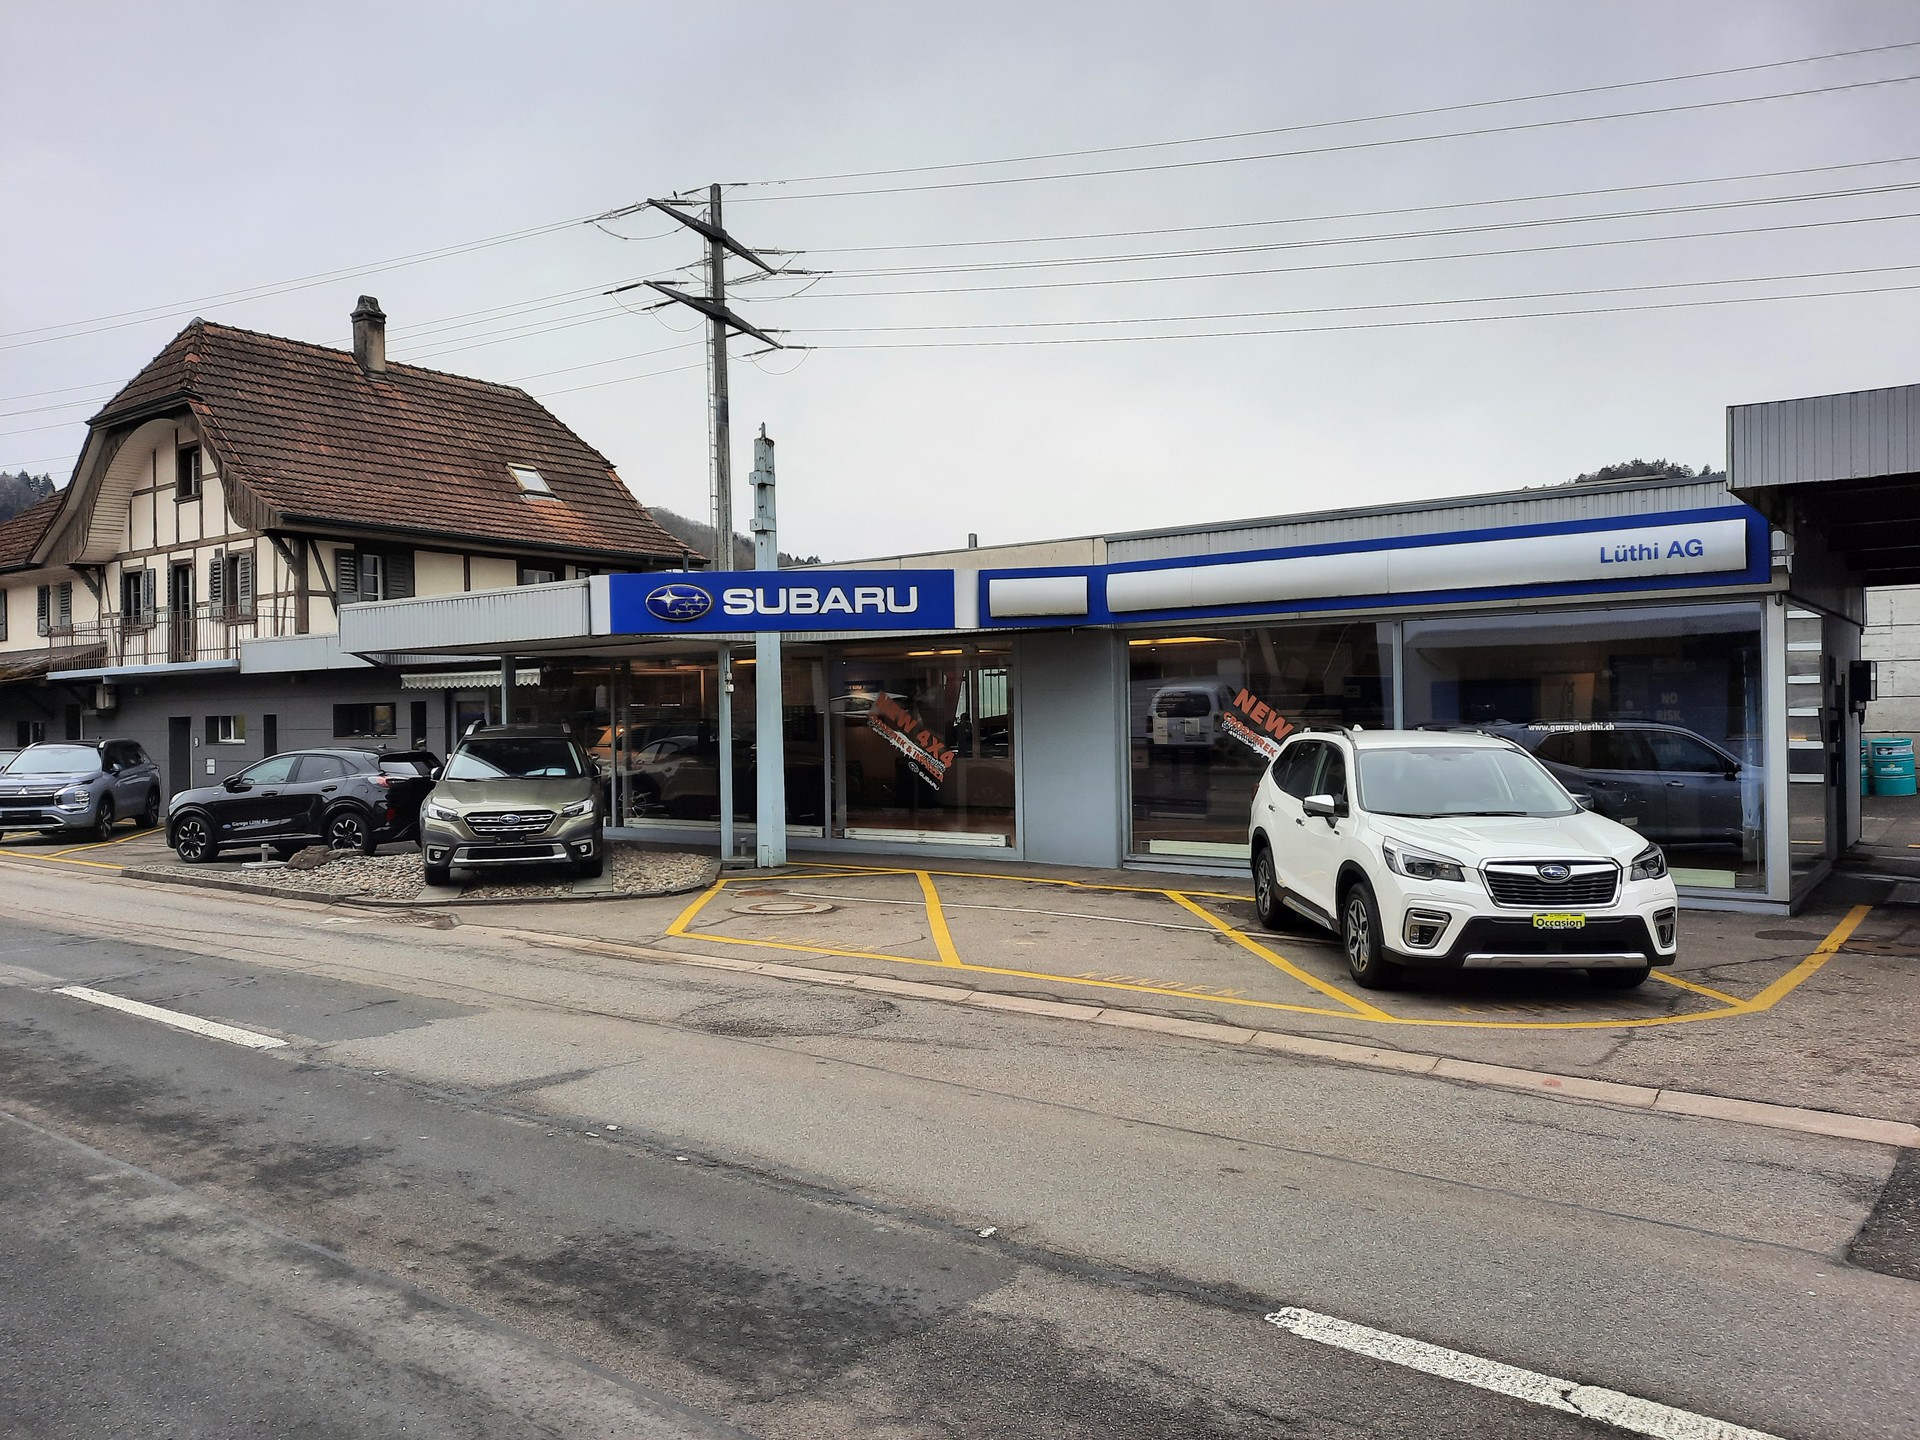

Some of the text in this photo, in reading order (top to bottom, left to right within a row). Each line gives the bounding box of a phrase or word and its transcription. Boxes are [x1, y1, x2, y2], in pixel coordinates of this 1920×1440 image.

[1600, 538, 1704, 563] Lüthi AG
[722, 586, 918, 615] SUBARU
[1661, 692, 1678, 704] NO
[1233, 687, 1295, 740] NEW
[1527, 722, 1615, 733] www.garageluethi.ch
[1536, 918, 1583, 927] Occasion
[1075, 971, 1248, 996] KUNDEN
